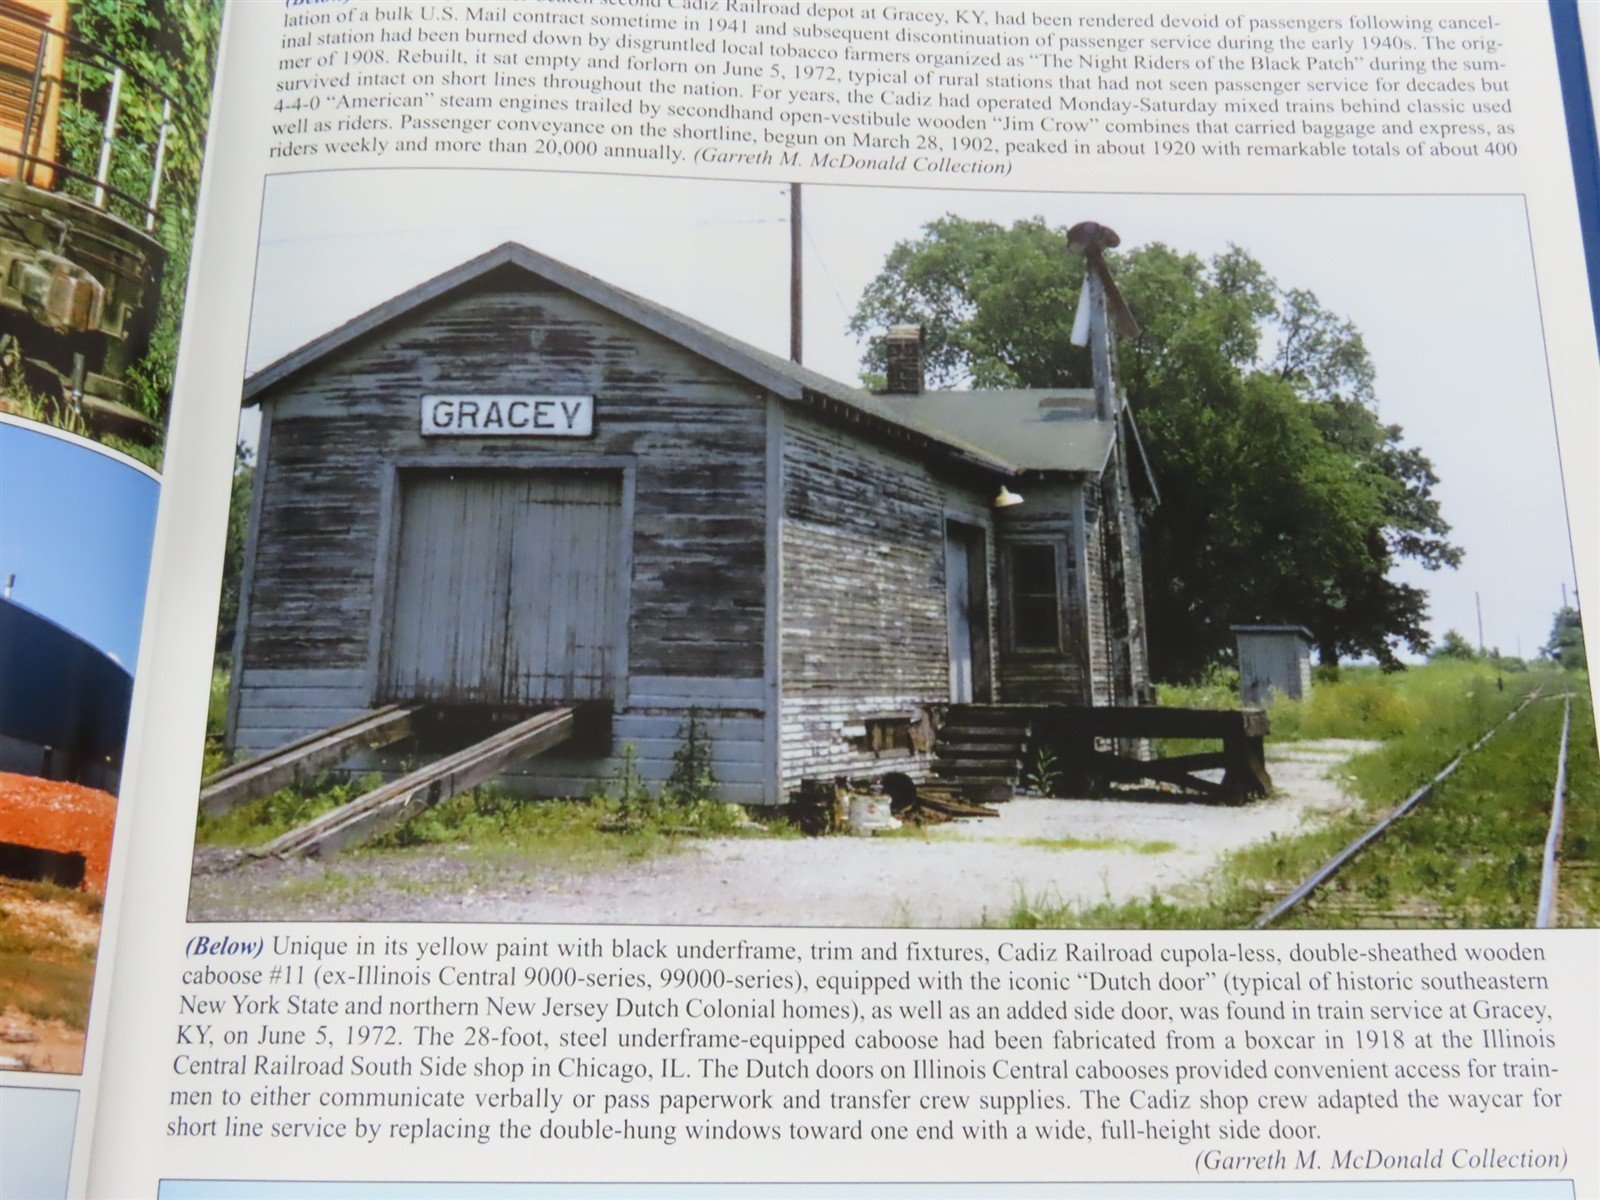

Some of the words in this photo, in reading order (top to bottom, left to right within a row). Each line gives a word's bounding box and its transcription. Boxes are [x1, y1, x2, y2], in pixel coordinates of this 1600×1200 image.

[725, 0, 800, 17] Railroad
[807, 2, 856, 22] depot
[861, 7, 876, 19] at
[882, 6, 949, 26] Gracey,
[954, 8, 988, 28] KY,
[995, 10, 1026, 26] had
[1031, 9, 1072, 28] been
[1078, 12, 1155, 30] rendered
[1160, 11, 1219, 29] devoid
[1225, 13, 1245, 30] of
[1249, 18, 1342, 33] passengers
[1349, 14, 1433, 34] following
[1439, 15, 1500, 31] cancel-
[282, 31, 312, 49] inal
[317, 28, 375, 46] station
[379, 27, 412, 43] had
[418, 27, 460, 43] been
[465, 25, 528, 46] burned
[530, 29, 583, 48] down
[588, 31, 611, 51] by
[615, 32, 716, 54] disgruntled
[721, 39, 763, 57] local
[769, 41, 839, 61] tobacco
[843, 44, 911, 64] farmers
[915, 50, 1001, 70] organized
[1006, 56, 1024, 68] as
[1078, 54, 1128, 73] Night
[1133, 54, 1191, 72] Riders
[1195, 54, 1215, 71] of
[1218, 56, 1245, 71] the
[1250, 54, 1301, 72] Black
[1369, 56, 1427, 75] during
[1430, 56, 1459, 72] the
[1463, 59, 1506, 71] sum-
[273, 95, 321, 114] 4-4-0
[440, 94, 493, 110] steam
[498, 93, 568, 114] engines
[574, 96, 633, 115] trailed
[638, 98, 663, 120] by
[666, 103, 774, 122] secondhand
[780, 110, 911, 128] open-vestibule
[915, 114, 986, 131] wooden
[1105, 117, 1191, 135] combines
[1196, 119, 1230, 136] that
[1234, 118, 1297, 136] carried
[1301, 118, 1376, 140] baggage
[1382, 120, 1414, 136] and
[1419, 122, 1491, 140] express,
[1496, 123, 1515, 136] as
[269, 140, 319, 159] riders
[325, 136, 389, 157] weekly
[395, 136, 428, 152] and
[433, 139, 481, 153] more
[488, 136, 527, 154] than
[534, 137, 598, 157] 20,000
[602, 143, 685, 165] annually.
[694, 145, 772, 167] (Garreth
[778, 151, 802, 167] M.
[810, 152, 908, 172] McDonald
[913, 156, 1012, 178] Collection)
[432, 401, 581, 429] GRACEY
[185, 935, 264, 960] (Below)
[274, 935, 348, 961] Unique
[356, 935, 375, 956] in
[384, 936, 408, 956] its
[416, 936, 488, 961] yellow
[495, 937, 550, 962] paint
[557, 937, 603, 958] with
[612, 938, 668, 959] black
[676, 939, 802, 964] underframe,
[811, 940, 853, 961] trim
[861, 941, 898, 961] and
[906, 941, 989, 965] fixtures,
[998, 942, 1057, 962] Cadiz
[1065, 942, 1153, 962] Railroad
[1160, 942, 1281, 968] cupola-less,
[1289, 942, 1457, 962] double-sheathed
[1464, 941, 1545, 961] wooden
[179, 995, 226, 1015] New
[232, 994, 280, 1015] York
[287, 995, 338, 1015] State
[345, 995, 382, 1016] and
[389, 995, 478, 1016] northern
[486, 996, 536, 1016] New
[542, 996, 609, 1023] Jersey
[615, 997, 679, 1018] Dutch
[686, 998, 775, 1019] Colonial
[782, 998, 865, 1024] homes),
[872, 1005, 892, 1020] as
[899, 999, 943, 1020] well
[949, 1005, 970, 1020] as
[977, 1005, 1000, 1020] an
[1007, 999, 1068, 1021] added
[1074, 1000, 1115, 1021] side
[1121, 1000, 1173, 1024] door,
[1179, 1006, 1219, 1021] was
[1226, 1000, 1286, 1021] found
[1291, 1000, 1311, 1021] in
[1317, 1000, 1364, 1020] train
[1370, 999, 1443, 1020] service
[1449, 1003, 1468, 1019] at
[1473, 1000, 1552, 1024] Gracey,
[169, 1090, 212, 1105] men
[222, 1088, 241, 1106] to
[250, 1085, 311, 1107] either
[319, 1086, 465, 1107] communicate
[475, 1087, 563, 1114] verbally
[573, 1093, 595, 1108] or
[603, 1093, 650, 1114] pass
[659, 1088, 774, 1115] paperwork
[783, 1089, 821, 1110] and
[830, 1088, 911, 1110] transfer
[920, 1095, 970, 1109] crew
[980, 1088, 1070, 1115] supplies.
[1080, 1089, 1120, 1110] The
[1129, 1089, 1191, 1110] Cadiz
[1200, 1088, 1248, 1115] shop
[1258, 1094, 1308, 1109] crew
[1318, 1088, 1398, 1115] adapted
[1407, 1088, 1439, 1108] the
[1448, 1093, 1523, 1113] waycar
[1532, 1087, 1562, 1108] for
[167, 1116, 217, 1137] short
[225, 1116, 263, 1137] line
[271, 1117, 346, 1138] service
[355, 1117, 381, 1143] by
[390, 1118, 491, 1144] replacing
[499, 1118, 531, 1139] the
[540, 1118, 677, 1145] double-hung
[685, 1118, 781, 1140] windows
[789, 1119, 863, 1140] toward
[871, 1125, 908, 1140] one
[916, 1119, 954, 1140] end
[961, 1119, 1008, 1140] with
[1016, 1125, 1027, 1140] a
[1035, 1119, 1092, 1143] wide,
[1101, 1118, 1212, 1146] full-height
[1219, 1118, 1260, 1140] side
[1269, 1118, 1320, 1140] door.
[1195, 1148, 1286, 1175] (Garreth
[1294, 1149, 1320, 1169] M.
[1330, 1148, 1443, 1170] McDonald
[1452, 1148, 1567, 1172] Collection)
